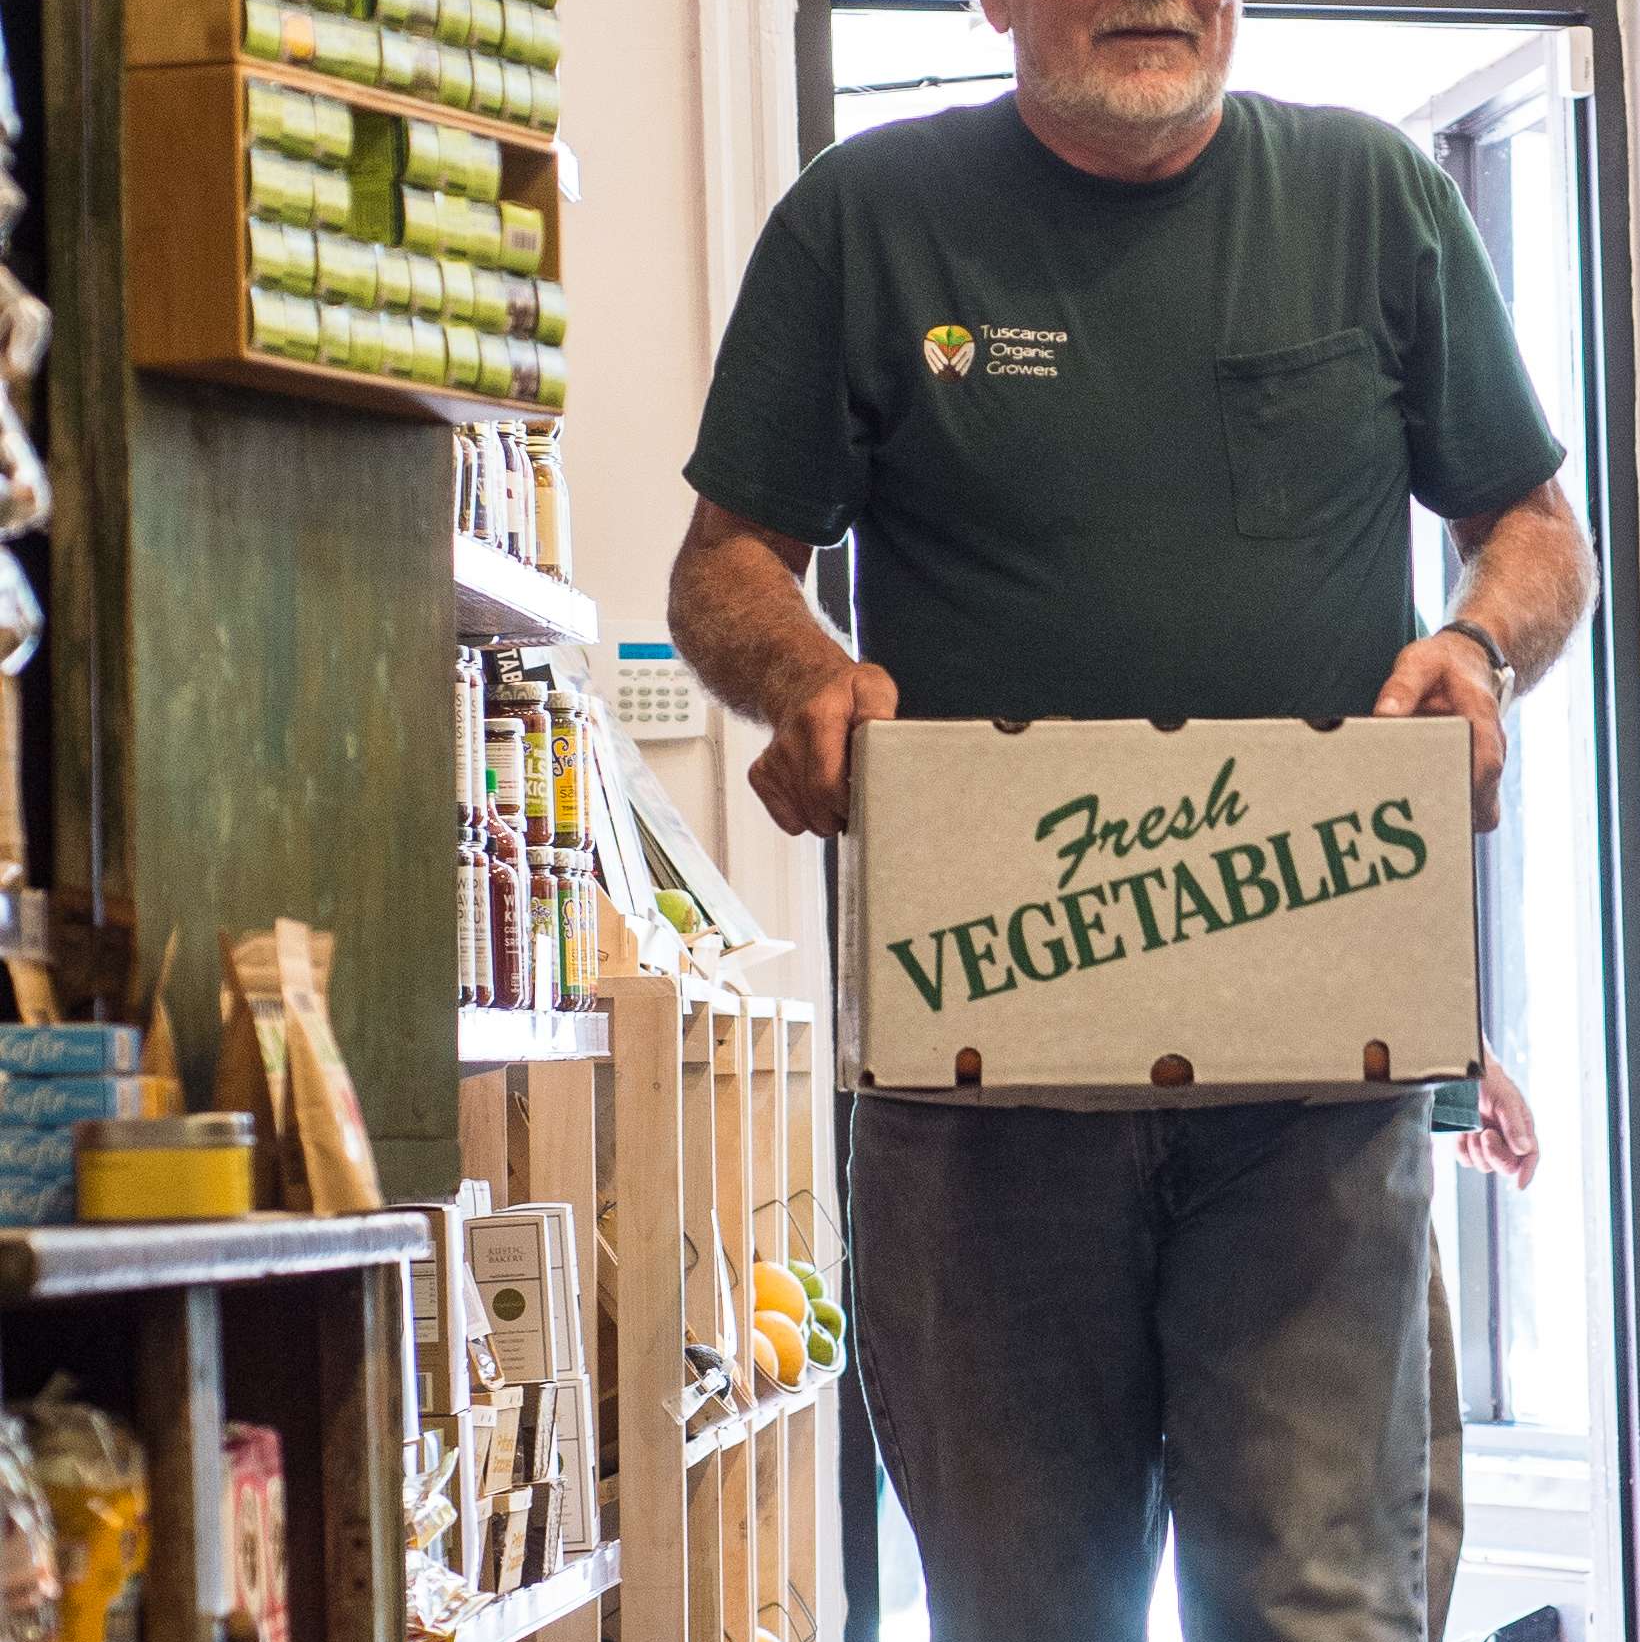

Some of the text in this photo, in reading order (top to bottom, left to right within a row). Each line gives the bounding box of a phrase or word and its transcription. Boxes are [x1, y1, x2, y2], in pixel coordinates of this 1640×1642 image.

[979, 324, 1068, 343] Tuscarora
[989, 342, 1055, 360] Organic
[986, 360, 1058, 377] Growers
[1034, 757, 1249, 890] Fresh
[887, 797, 1429, 1012] VEGETABLES
